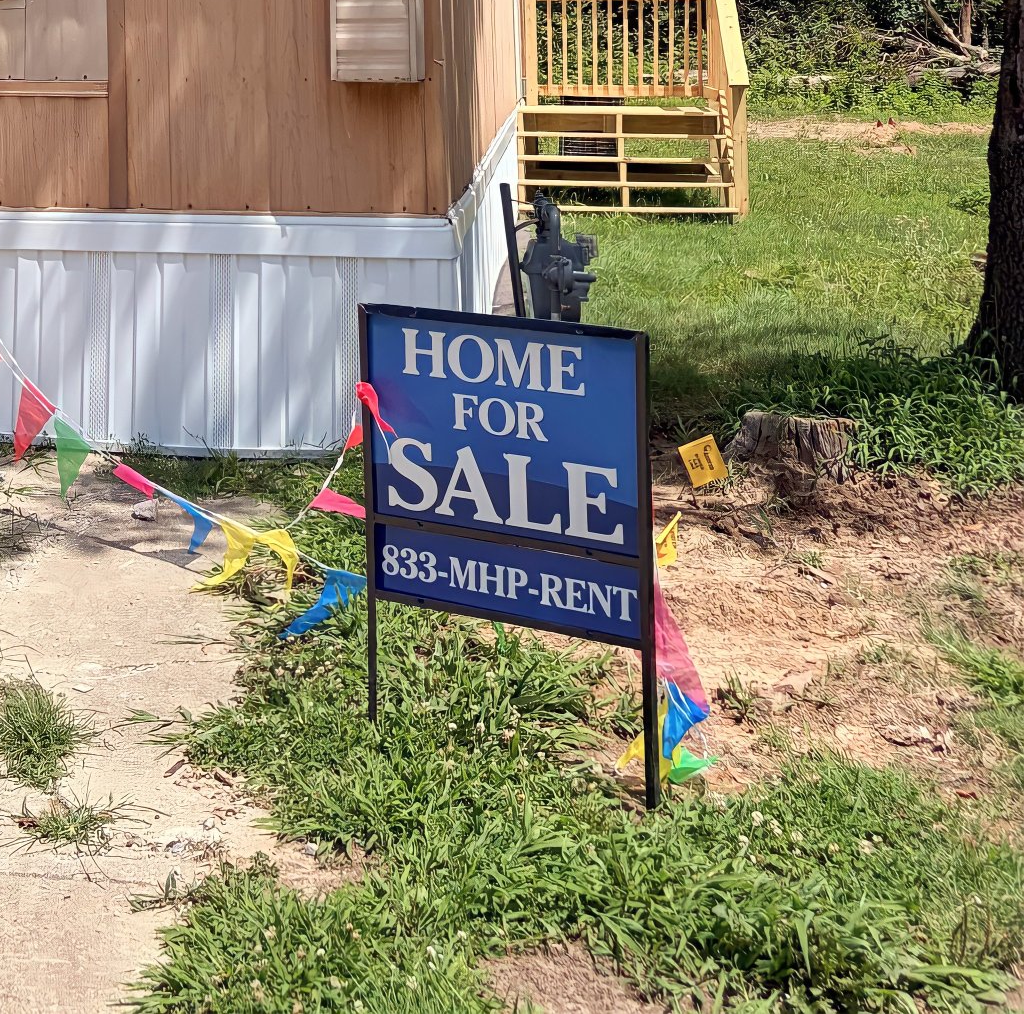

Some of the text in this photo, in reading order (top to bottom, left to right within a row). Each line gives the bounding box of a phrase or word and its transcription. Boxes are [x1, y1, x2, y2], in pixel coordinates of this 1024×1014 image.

[402, 328, 585, 396] HOME
[453, 393, 549, 442] FOR
[388, 438, 624, 544] SALE
[382, 545, 638, 621] 833-MHP-RENT
